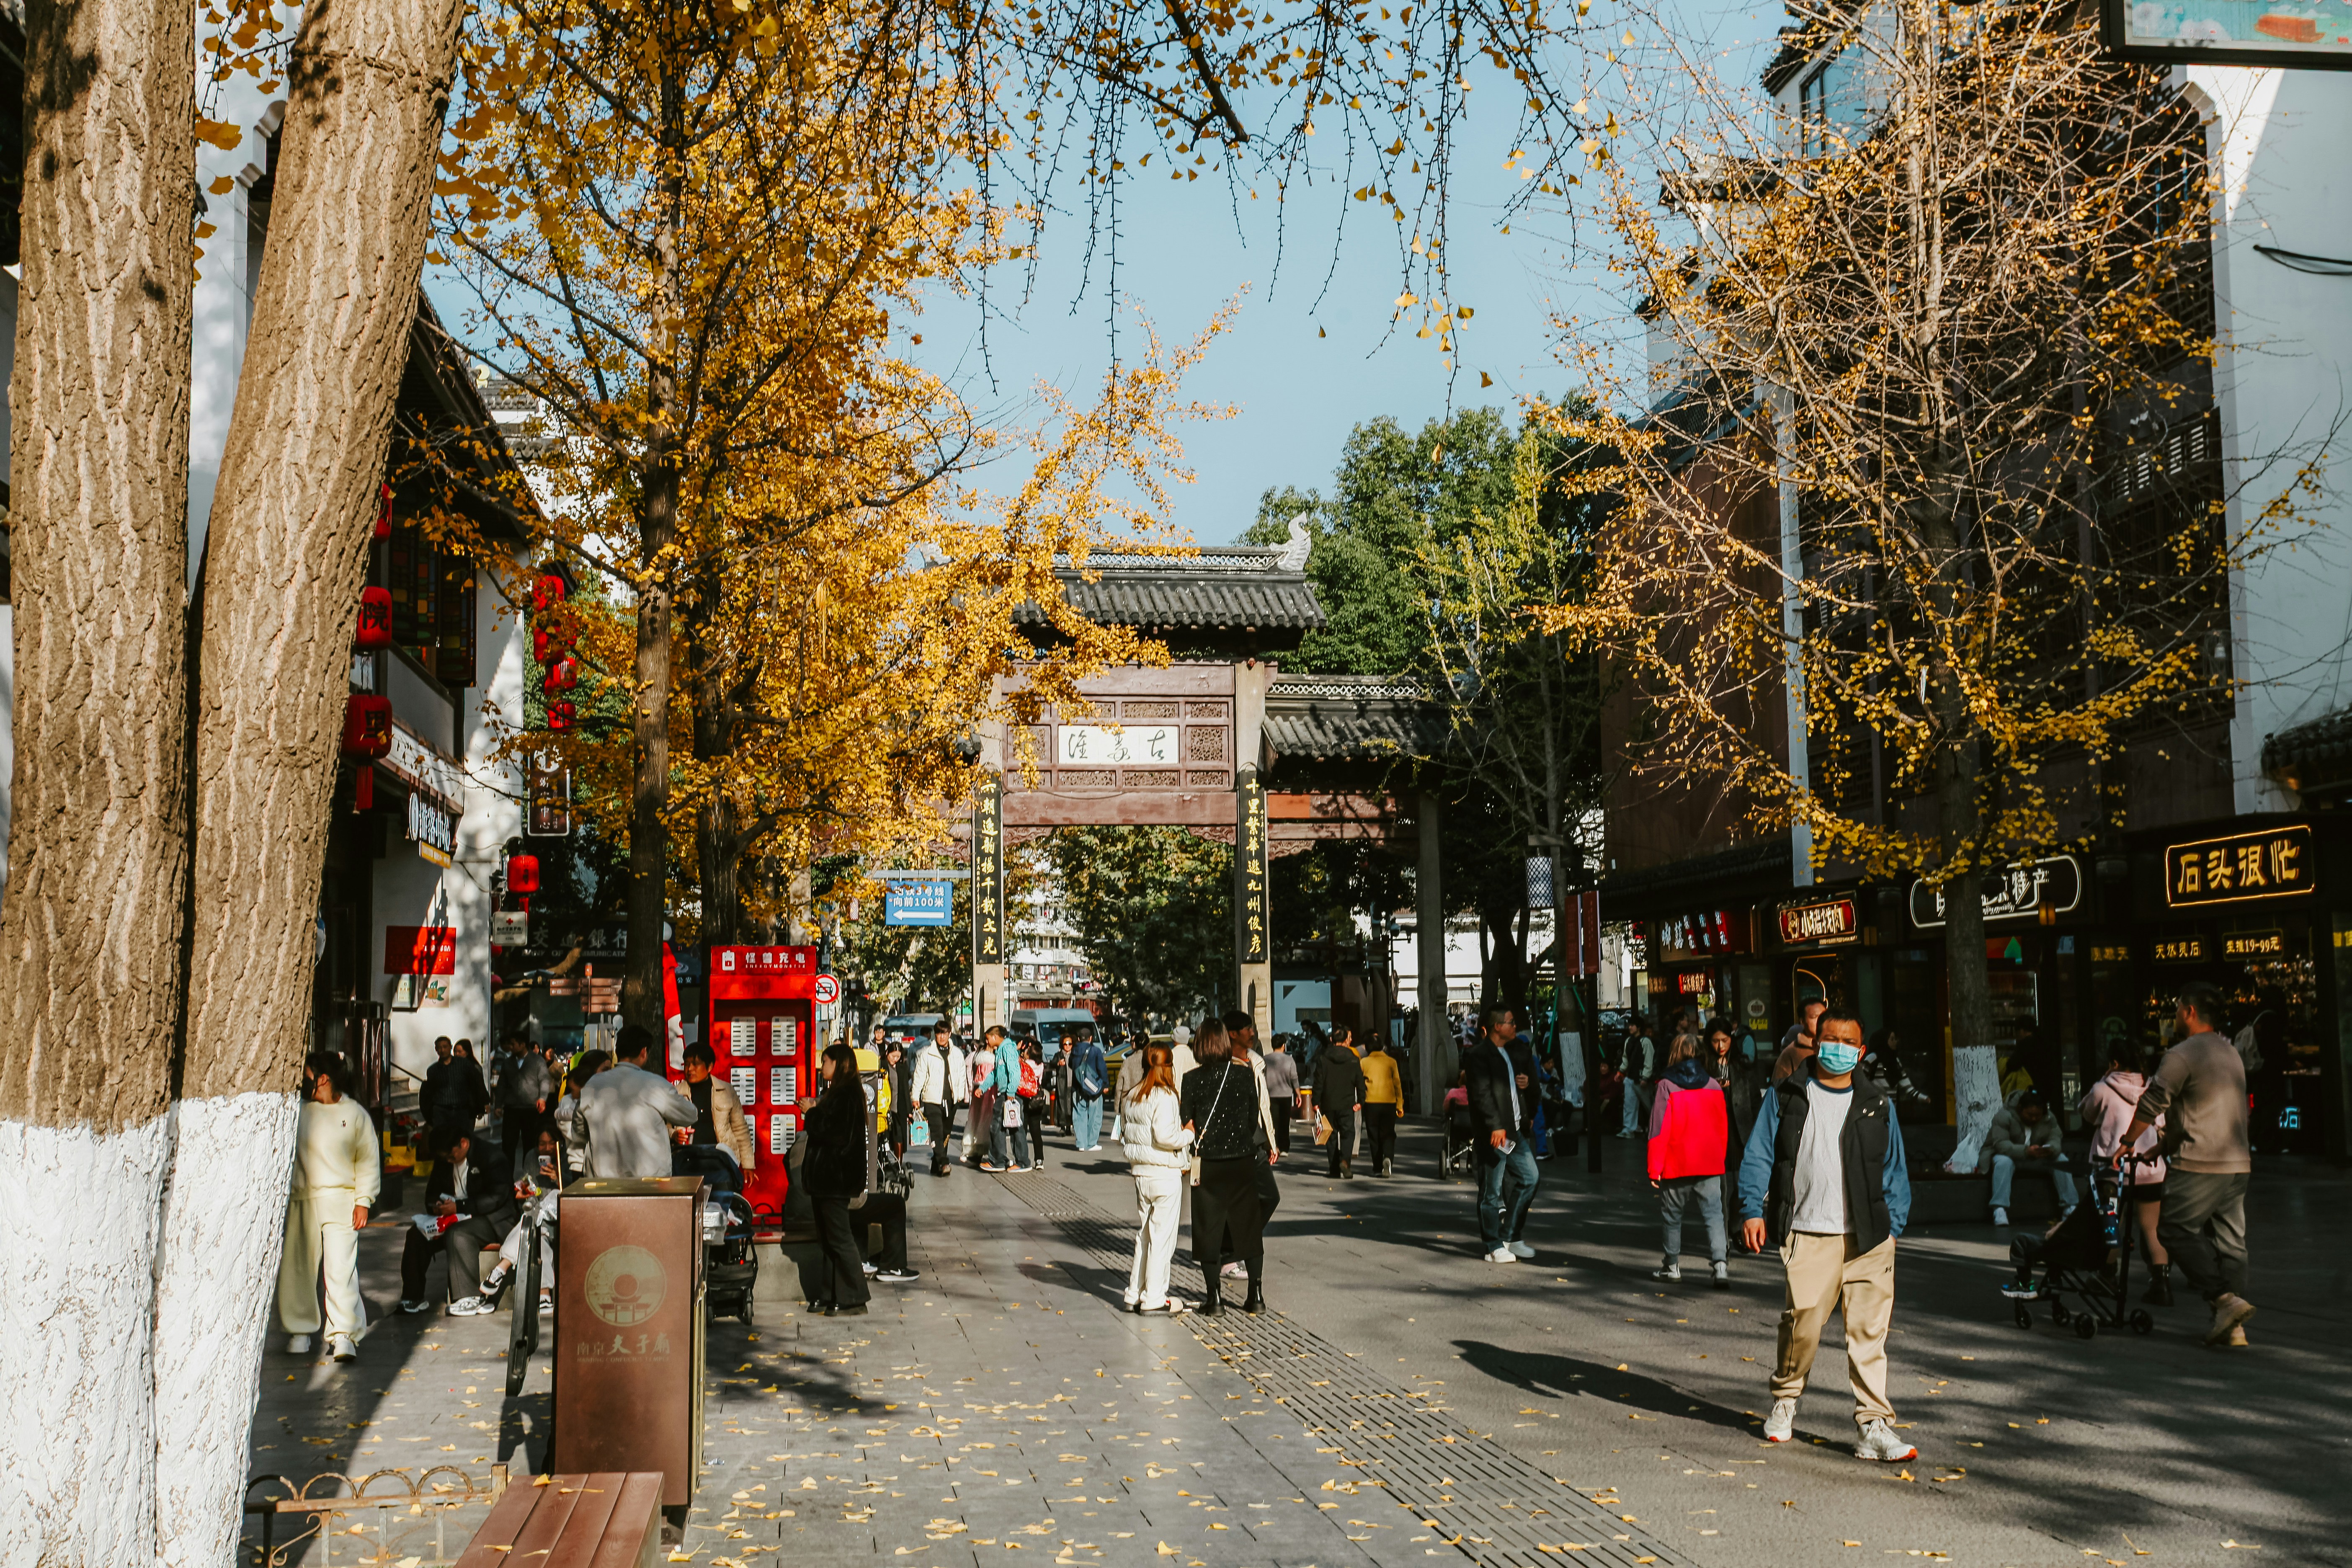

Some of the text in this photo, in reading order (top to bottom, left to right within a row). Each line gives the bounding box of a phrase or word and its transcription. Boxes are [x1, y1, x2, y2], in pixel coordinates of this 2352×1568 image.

[362, 601, 389, 631] 院
[2178, 839, 2300, 894] 石头很忙
[893, 885, 945, 897] 地铁3号线
[893, 897, 944, 908] 向前100米
[745, 952, 805, 964] 怪兽充电
